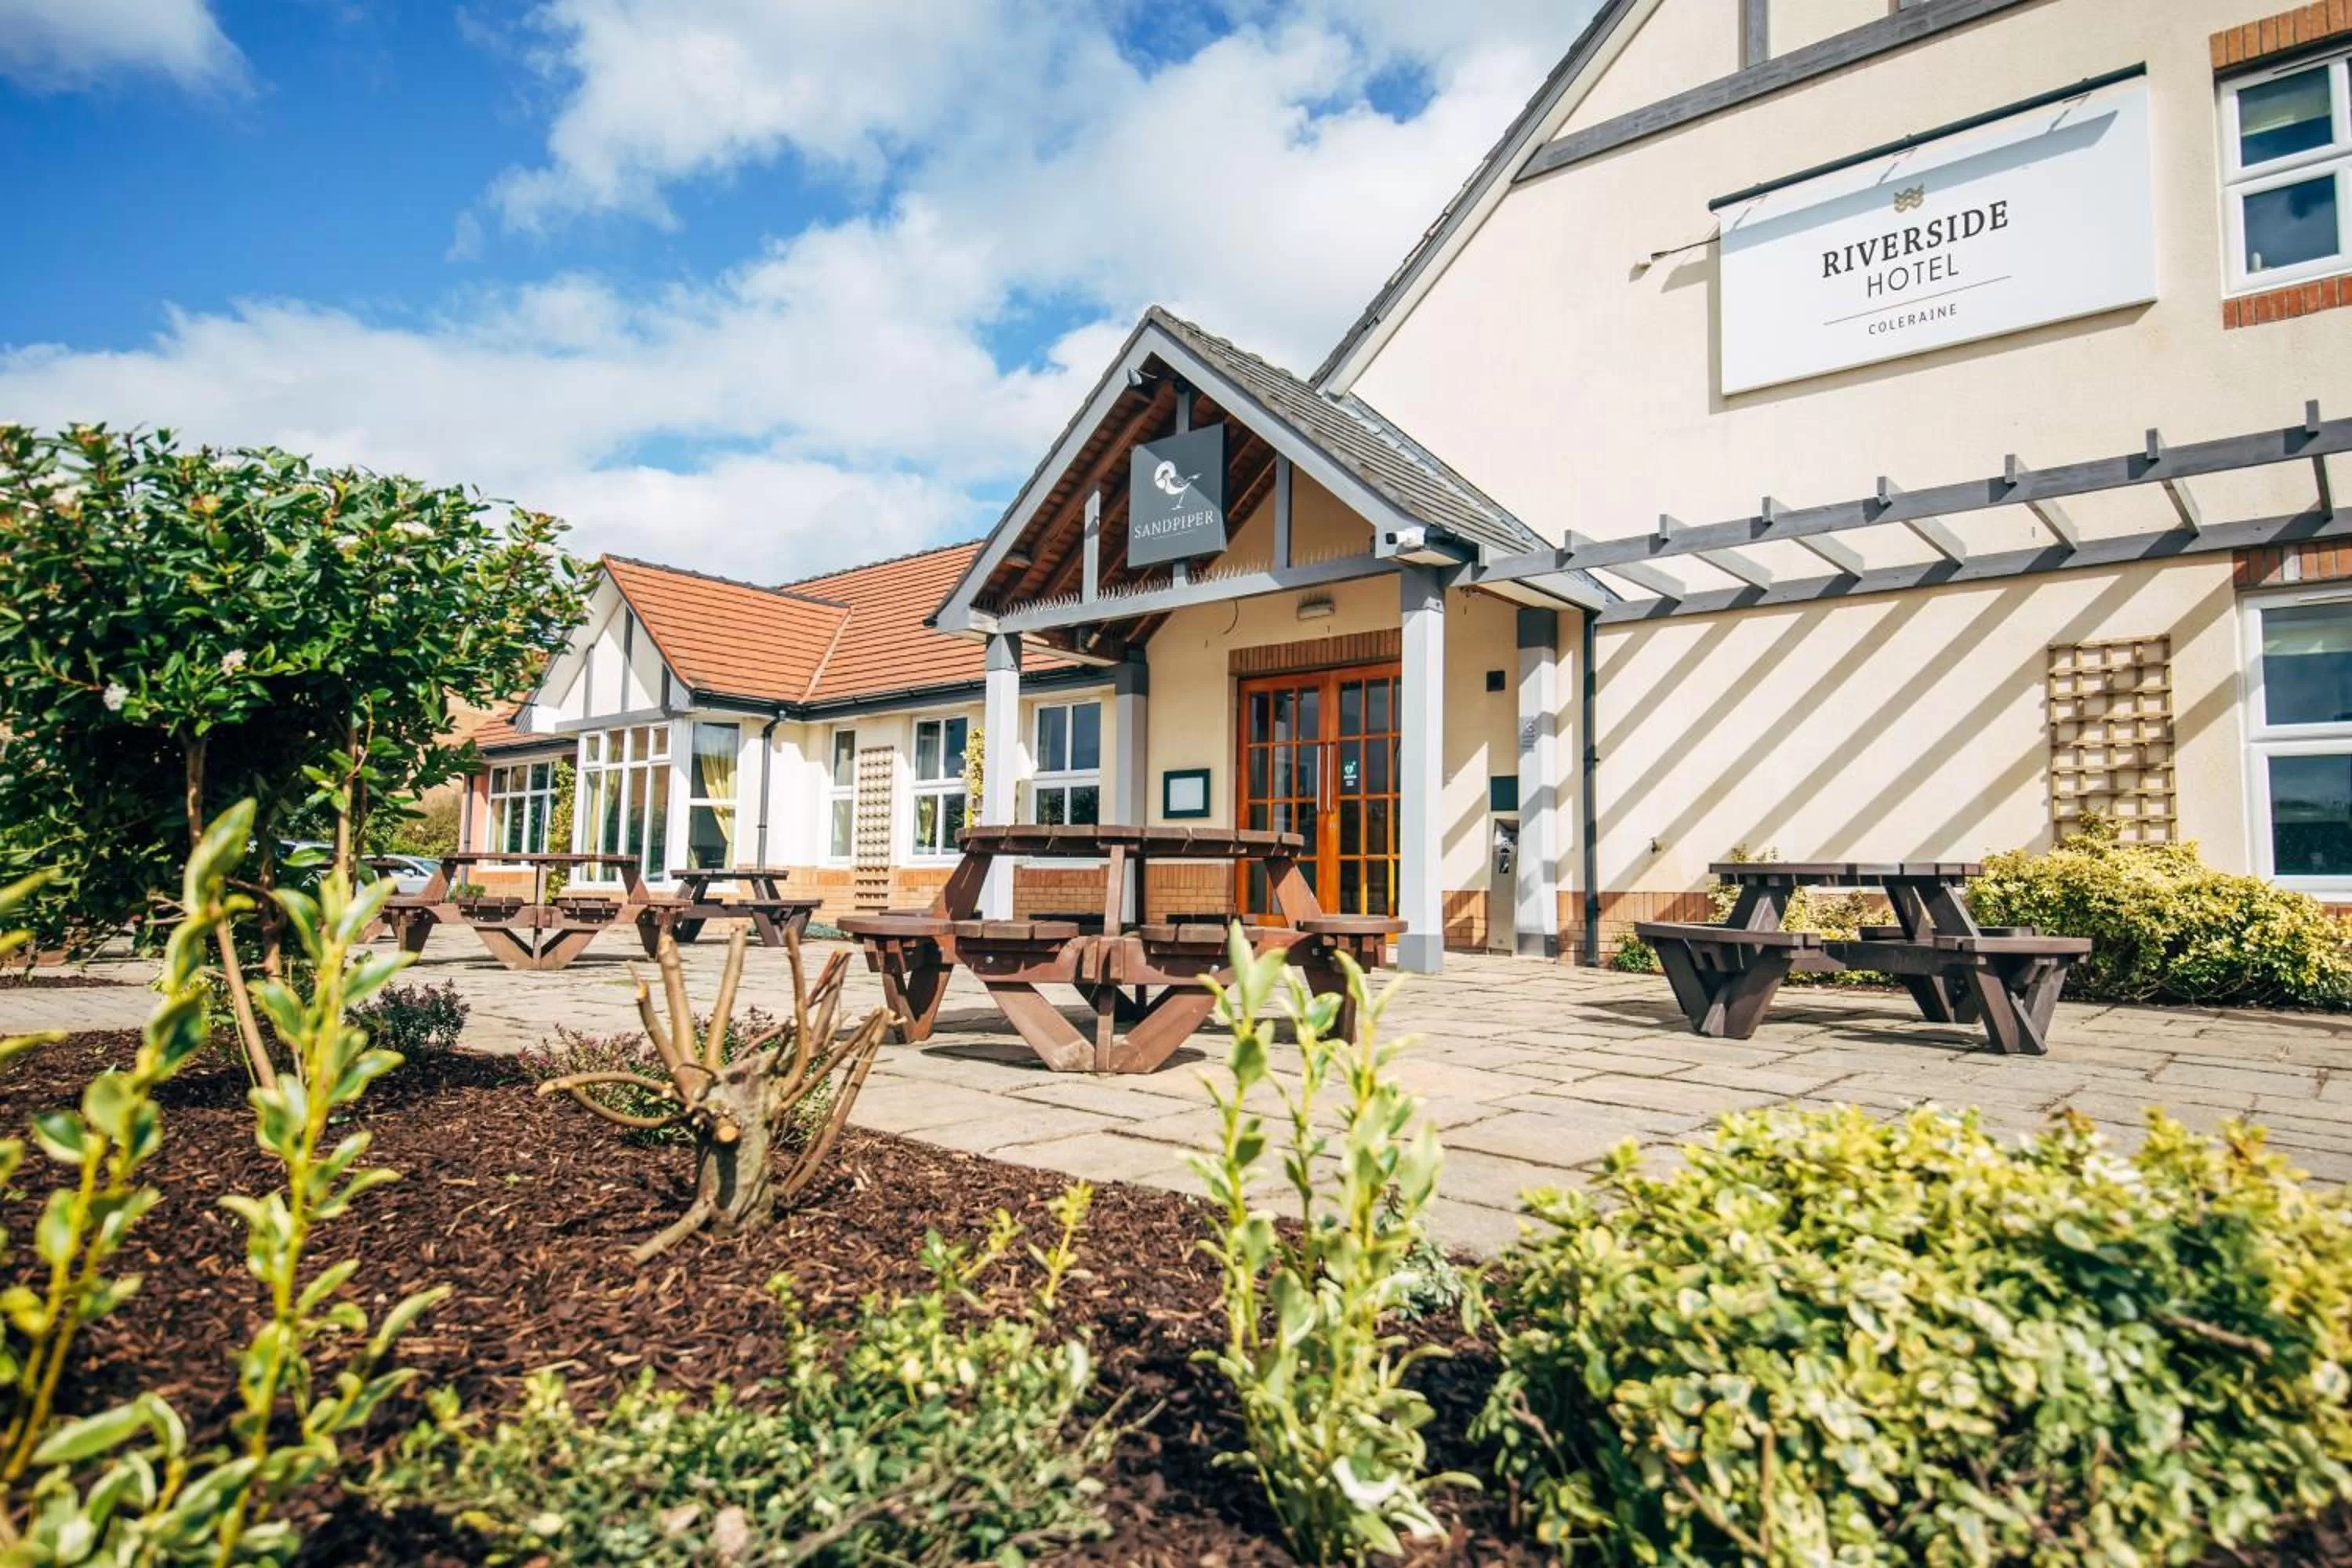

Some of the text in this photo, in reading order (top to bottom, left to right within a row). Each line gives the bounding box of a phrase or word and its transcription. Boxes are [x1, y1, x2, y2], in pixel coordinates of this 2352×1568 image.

[1822, 200, 2008, 278] RIVERSIDE
[1867, 253, 1958, 298] HOTEL
[1867, 303, 1957, 335] COLERAINE
[1134, 510, 1214, 539] SANDPIPER
